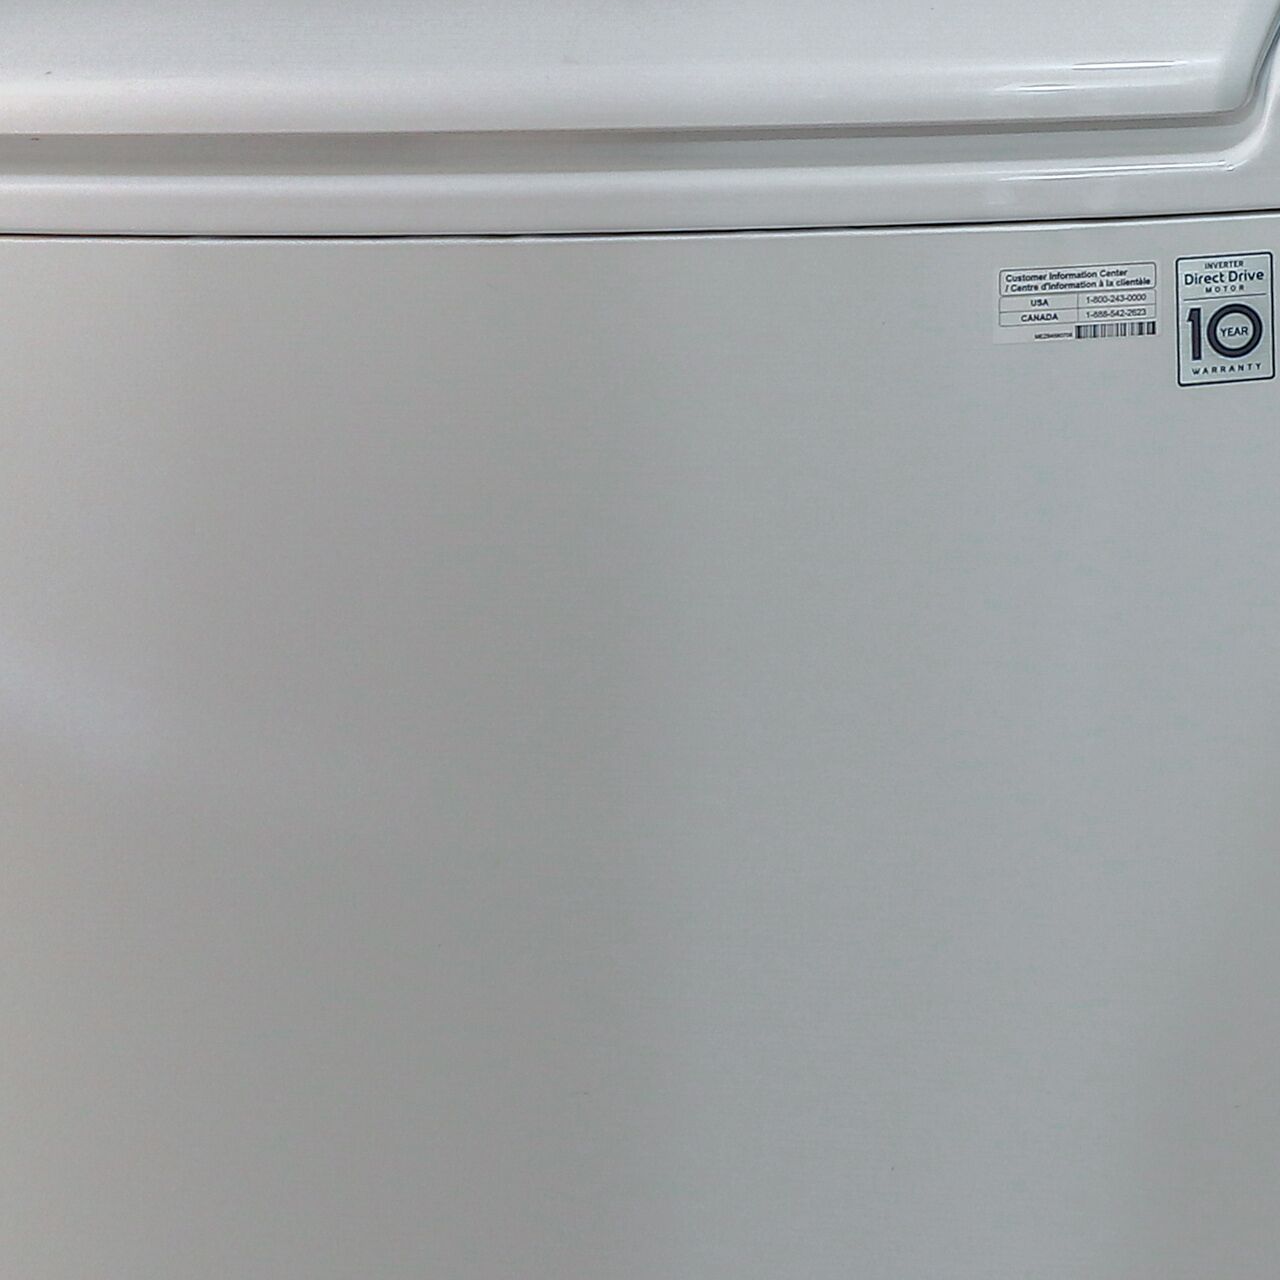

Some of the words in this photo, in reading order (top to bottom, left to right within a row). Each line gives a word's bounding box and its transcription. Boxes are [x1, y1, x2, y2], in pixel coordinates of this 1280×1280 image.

[1204, 260, 1244, 269] INVERTER
[1005, 272, 1048, 283] Customer
[1049, 270, 1098, 281] Information
[1099, 268, 1128, 278] Center
[1184, 271, 1226, 286] Direct
[1228, 270, 1265, 283] Drive
[1010, 283, 1039, 293] Centre
[1105, 279, 1114, 287] la
[1115, 276, 1151, 287] clientèle
[1205, 285, 1245, 293] MOTOR
[1030, 298, 1049, 307] USA
[1085, 293, 1147, 304] 1-800-243-0000
[1020, 313, 1059, 323] CANADA
[1187, 302, 1263, 361] 10
[1220, 326, 1249, 337] YEAR
[1192, 363, 1262, 375] WARRANTY
